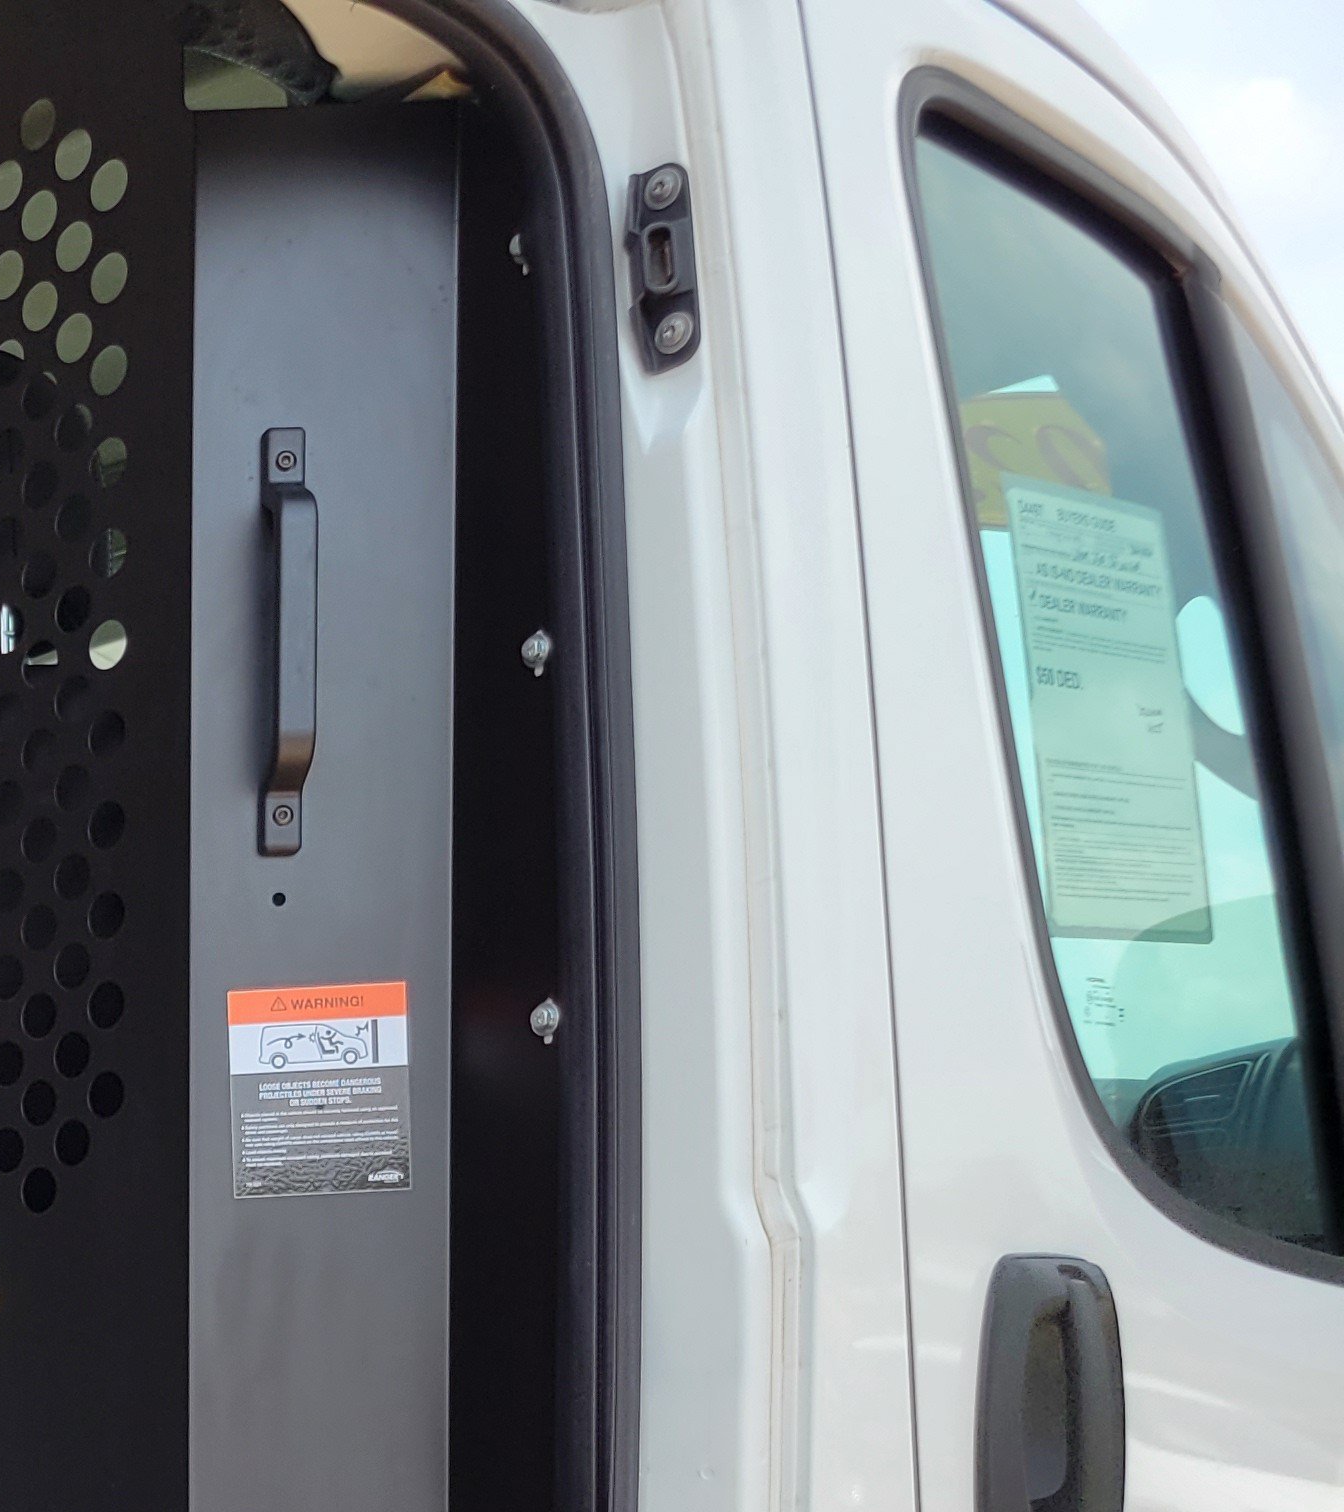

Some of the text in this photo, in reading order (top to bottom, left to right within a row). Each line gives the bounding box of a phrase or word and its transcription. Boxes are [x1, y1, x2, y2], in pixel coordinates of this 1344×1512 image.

[1113, 576, 1161, 598] WARRANTY
[1038, 593, 1127, 622] DEALER WARRANTY
[290, 996, 364, 1010] WARNING!
[259, 1077, 381, 1092] LOOSE OBJECTS BECOME DANGEROUS
[258, 1086, 382, 1100] PROJECTILES UNDER SEVERE BRAKING
[289, 1098, 299, 1107] OR
[300, 1097, 327, 1106] SUDDEN
